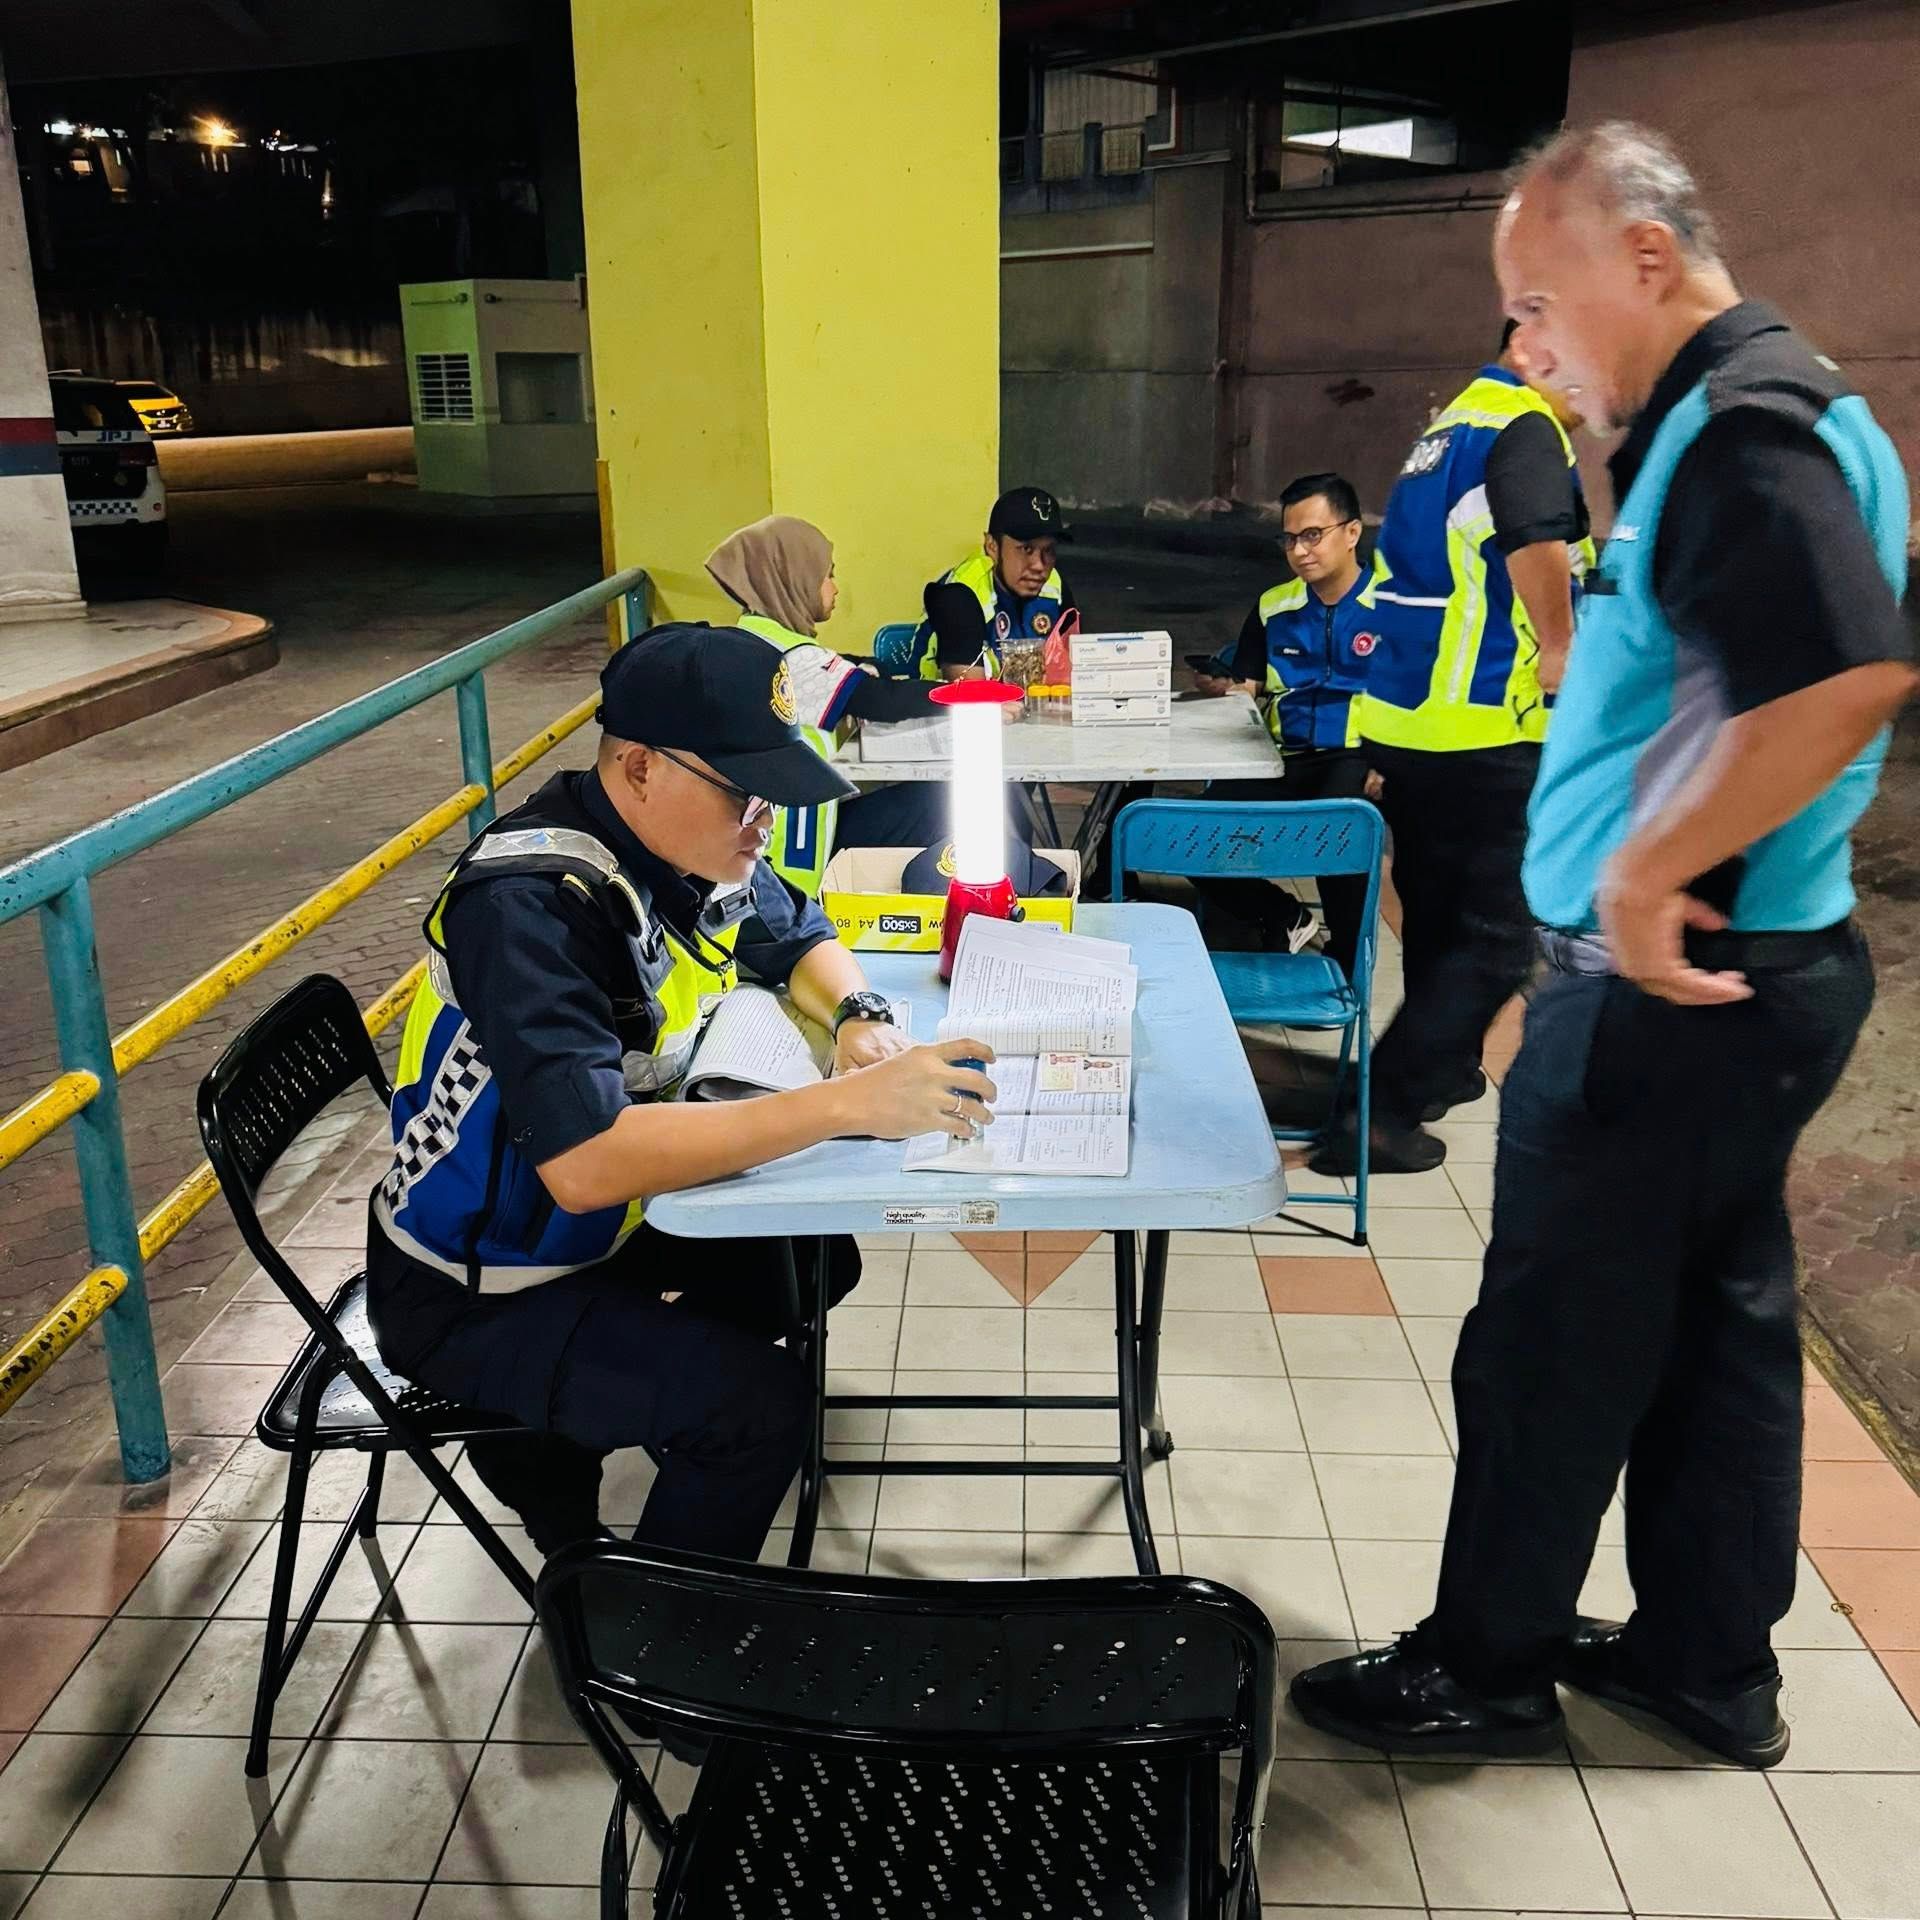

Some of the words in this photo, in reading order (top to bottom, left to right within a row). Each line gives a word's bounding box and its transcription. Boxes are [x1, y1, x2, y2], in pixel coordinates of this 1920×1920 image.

[97, 431, 132, 442] JPJ
[836, 918, 851, 929] 80
[859, 919, 875, 929] A4
[882, 919, 917, 931] 5x500
[886, 1211, 902, 1220] high
